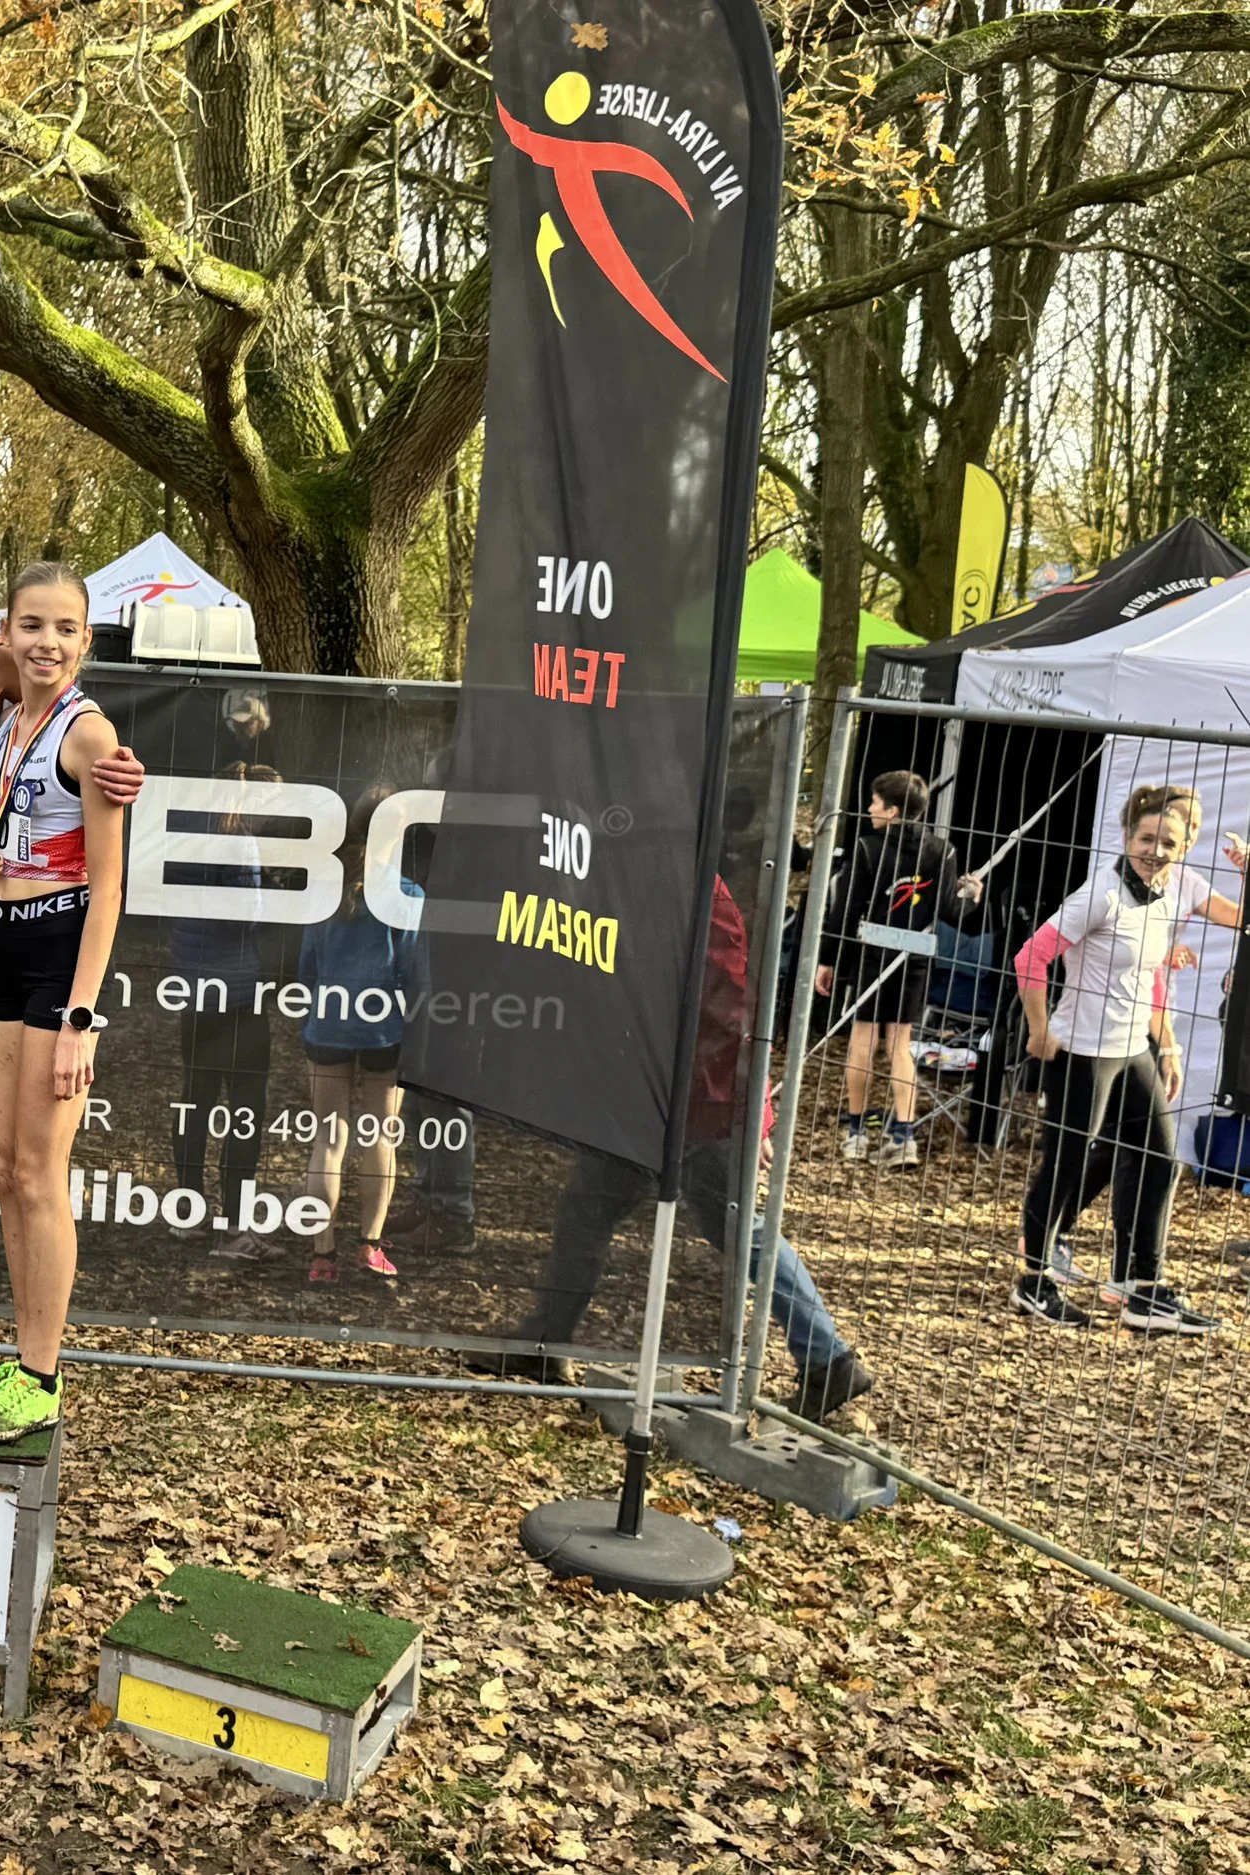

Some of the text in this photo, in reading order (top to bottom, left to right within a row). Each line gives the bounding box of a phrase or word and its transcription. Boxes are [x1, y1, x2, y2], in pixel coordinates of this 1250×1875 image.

[10, 893, 75, 922] NIKE
[156, 975, 228, 1014] en
[253, 979, 565, 1030] renoveren
[170, 1103, 196, 1136] T
[208, 1105, 256, 1140] 03
[268, 1109, 339, 1145] 491
[356, 1113, 406, 1149] 99
[418, 1117, 468, 1152] 00
[213, 1706, 236, 1750] 3
